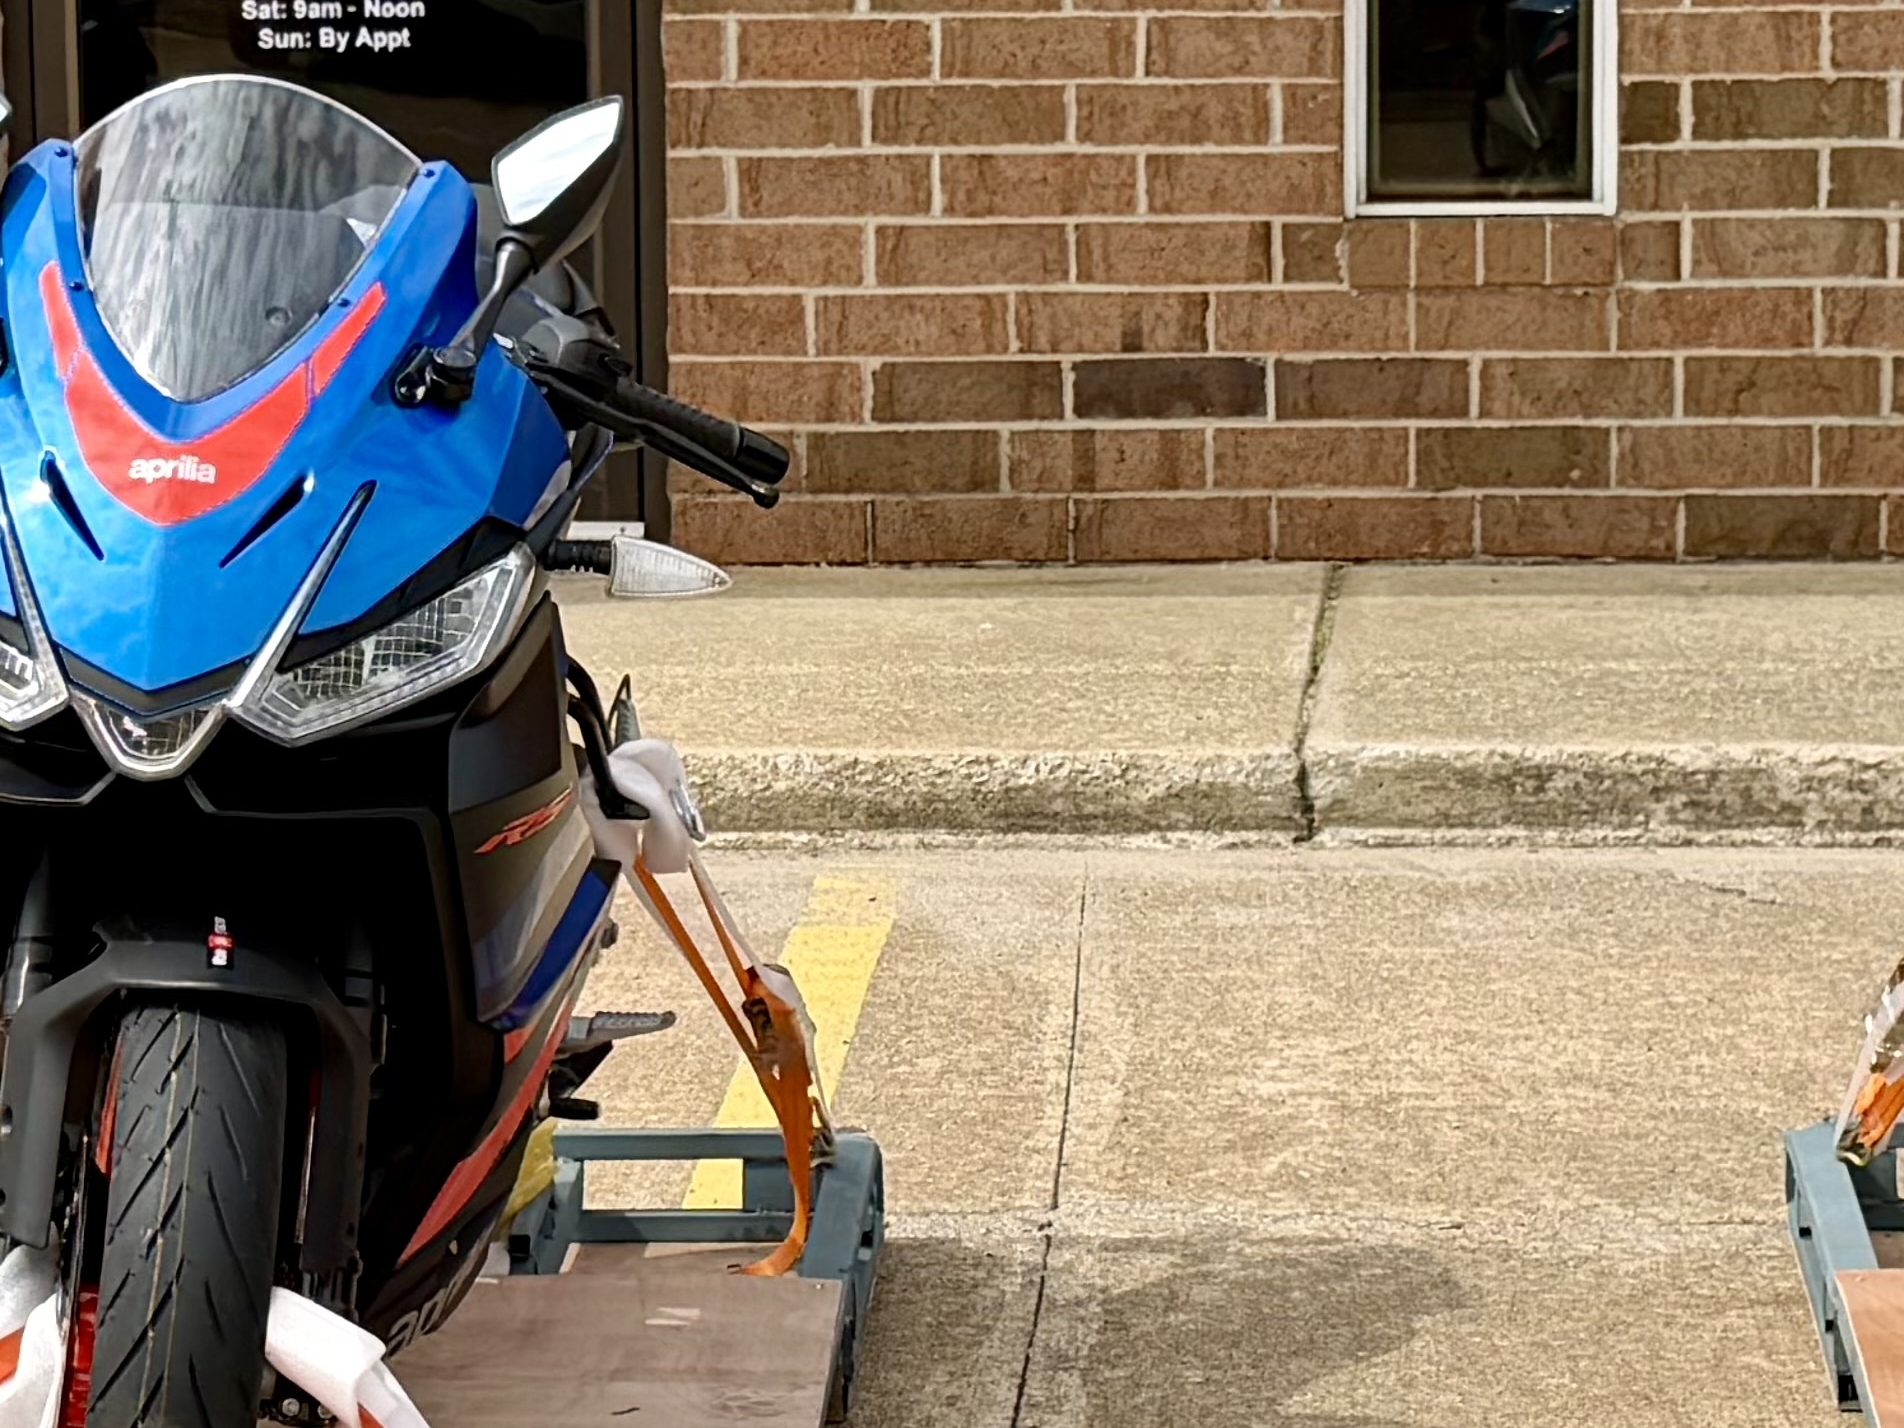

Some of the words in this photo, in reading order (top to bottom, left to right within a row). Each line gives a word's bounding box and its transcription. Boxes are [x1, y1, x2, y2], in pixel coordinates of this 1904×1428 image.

[257, 27, 312, 50] Sun:
[318, 26, 350, 53] By
[355, 26, 411, 53] Appt
[128, 453, 217, 484] aprilia
